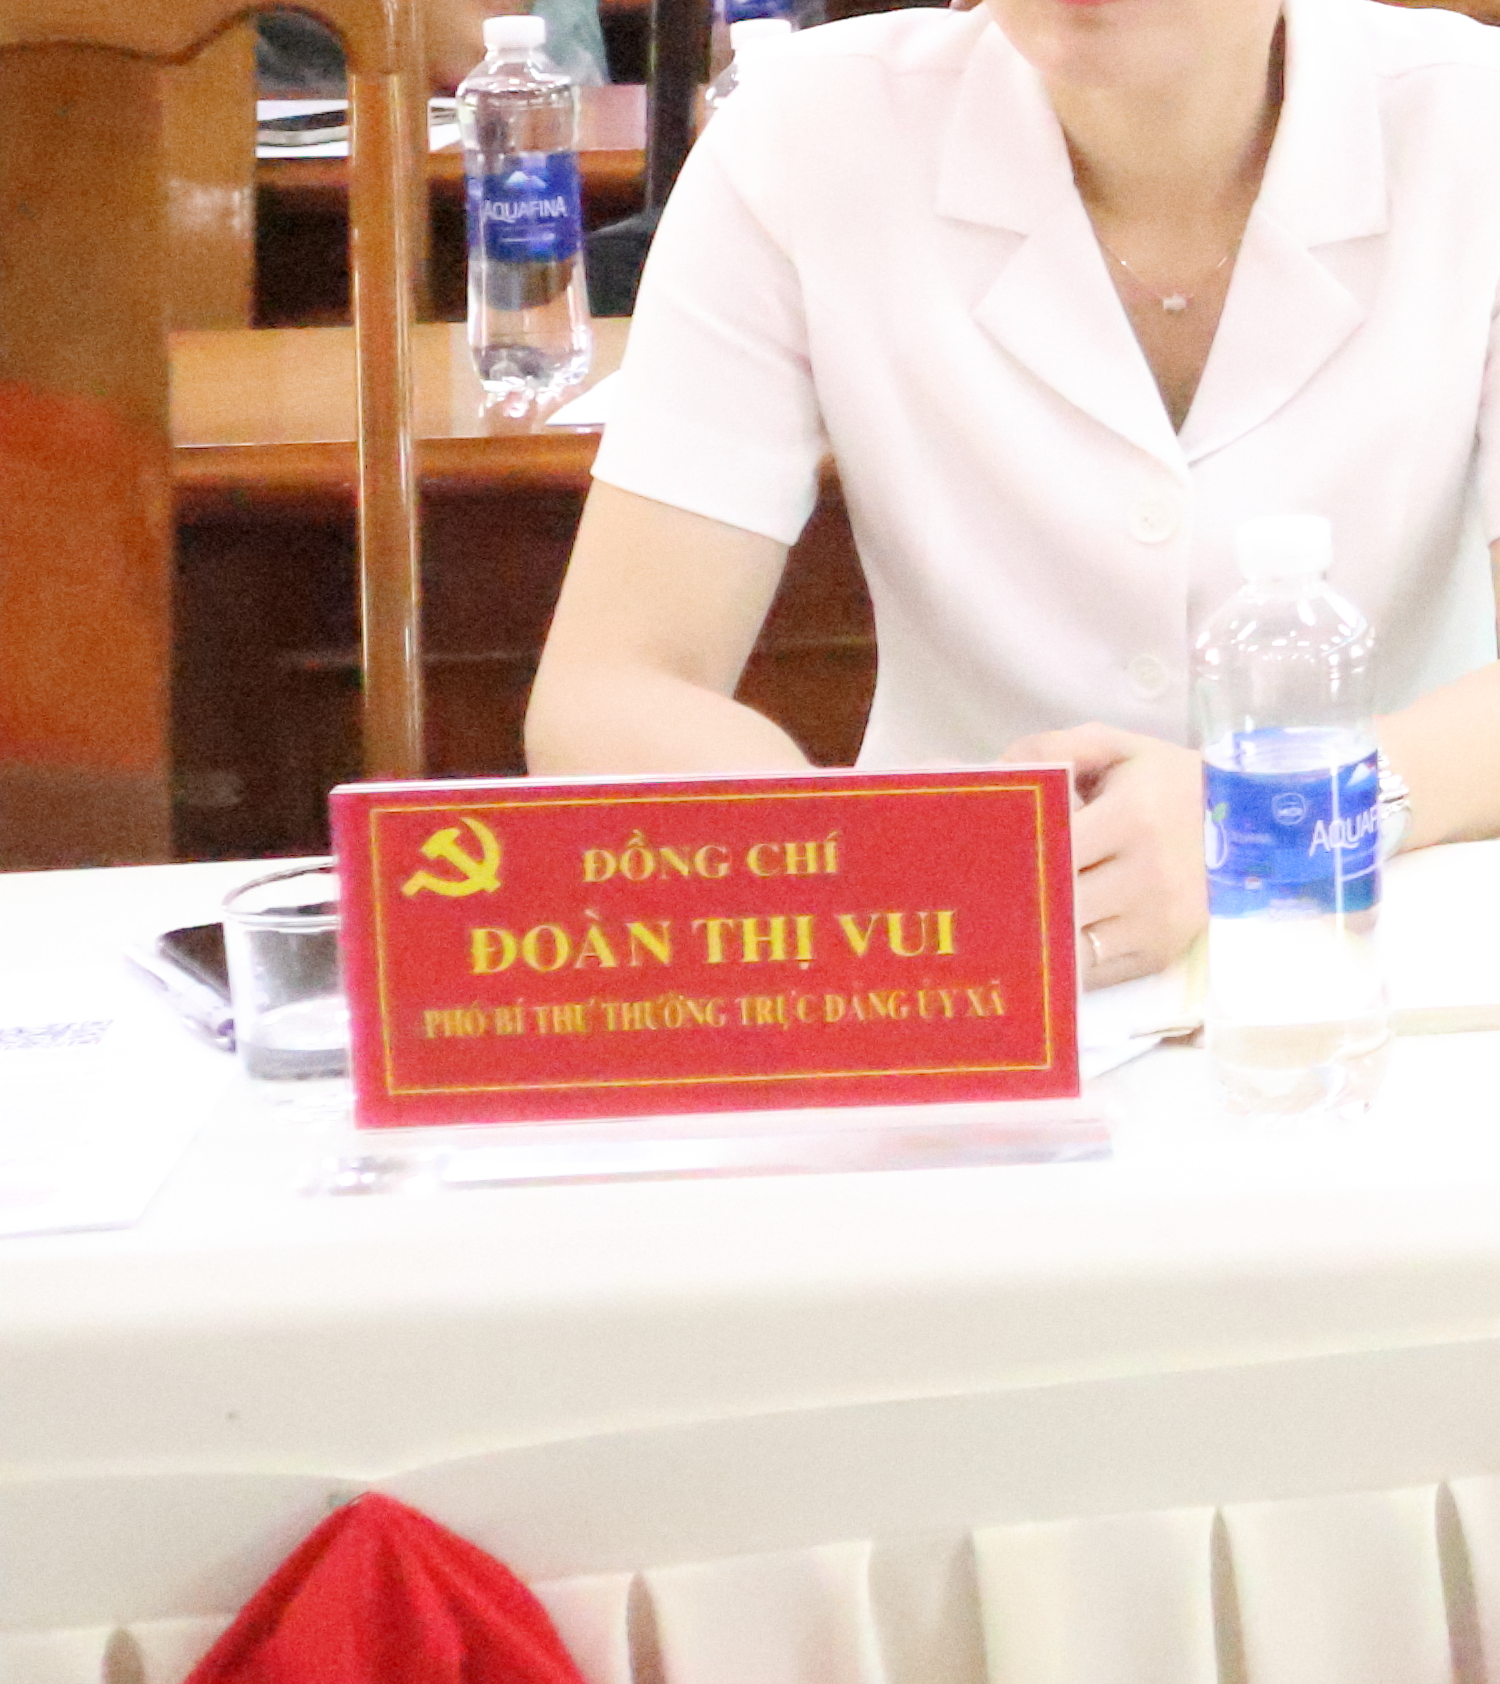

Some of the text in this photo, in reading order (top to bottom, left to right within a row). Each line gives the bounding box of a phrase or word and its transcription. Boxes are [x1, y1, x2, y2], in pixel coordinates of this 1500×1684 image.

[482, 196, 568, 223] AQUAFINA
[582, 829, 842, 883] ĐỒNG CHÍ
[469, 909, 957, 975] ĐOÀN THỊ VUI
[422, 1000, 488, 1039] PHÓ
[494, 997, 525, 1036] BÍ
[532, 996, 596, 1036] THƯ
[601, 991, 726, 1032] THƯỜNG
[735, 989, 816, 1031] TRỰC
[823, 980, 909, 1023] ĐẢNG
[964, 978, 1005, 1019] XÃ
